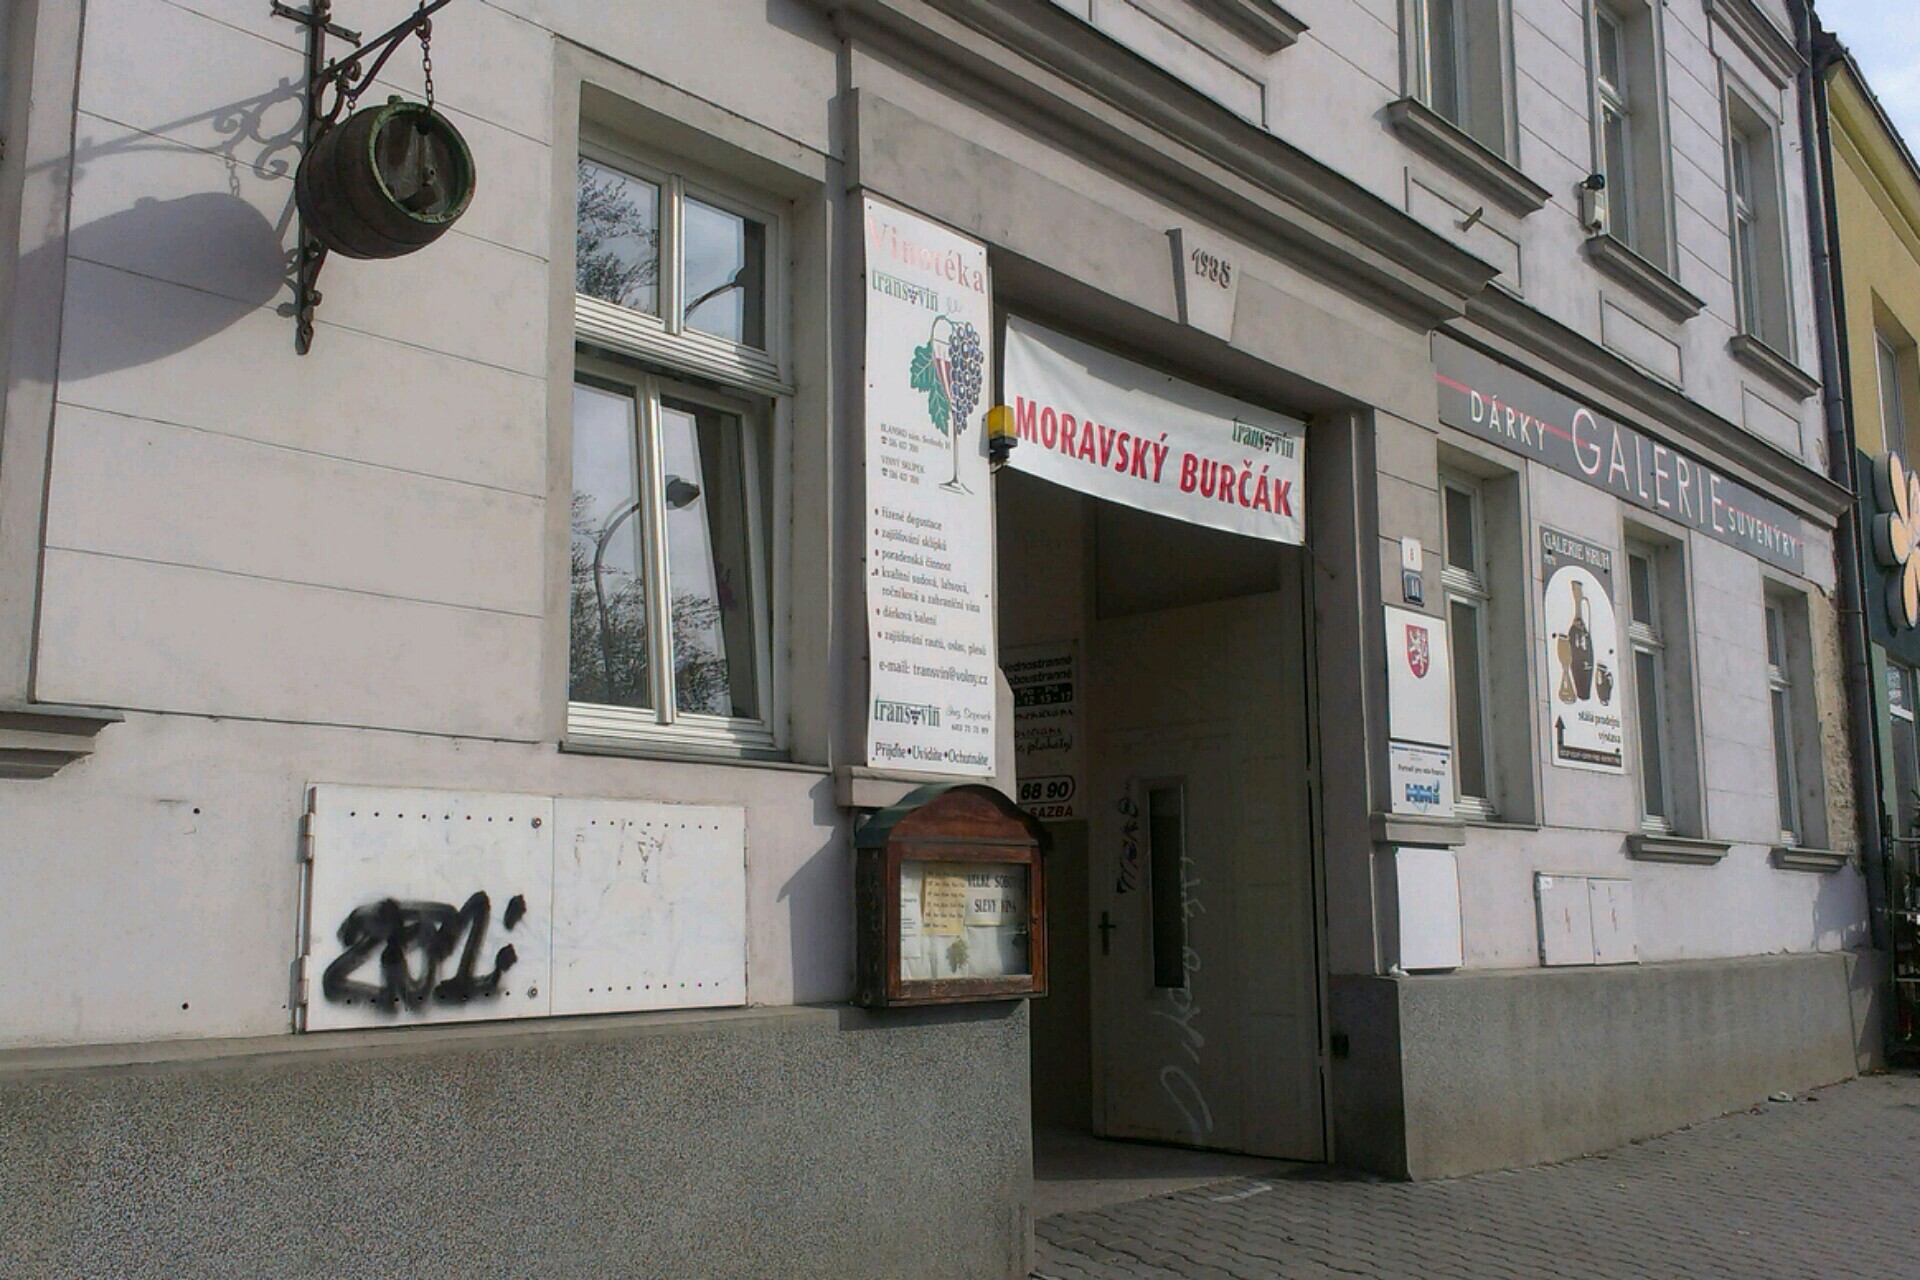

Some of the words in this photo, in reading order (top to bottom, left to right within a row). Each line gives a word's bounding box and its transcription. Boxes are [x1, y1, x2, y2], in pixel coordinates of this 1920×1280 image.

[867, 217, 985, 295] Vinotéka
[1014, 395, 1170, 484] MORAVSKÝ
[1179, 452, 1293, 517] BURČÁK
[1470, 390, 1546, 451] DÁRKY
[1571, 408, 1725, 534] GALERIE
[1728, 506, 1797, 560] SUVENÝRY
[906, 512, 942, 531] degustace
[1543, 531, 1584, 560] GALERIE
[881, 549, 924, 566] poradenská
[925, 556, 952, 571] činnost
[913, 664, 988, 686] transvin@volny.cz
[1047, 781, 1069, 798] 90
